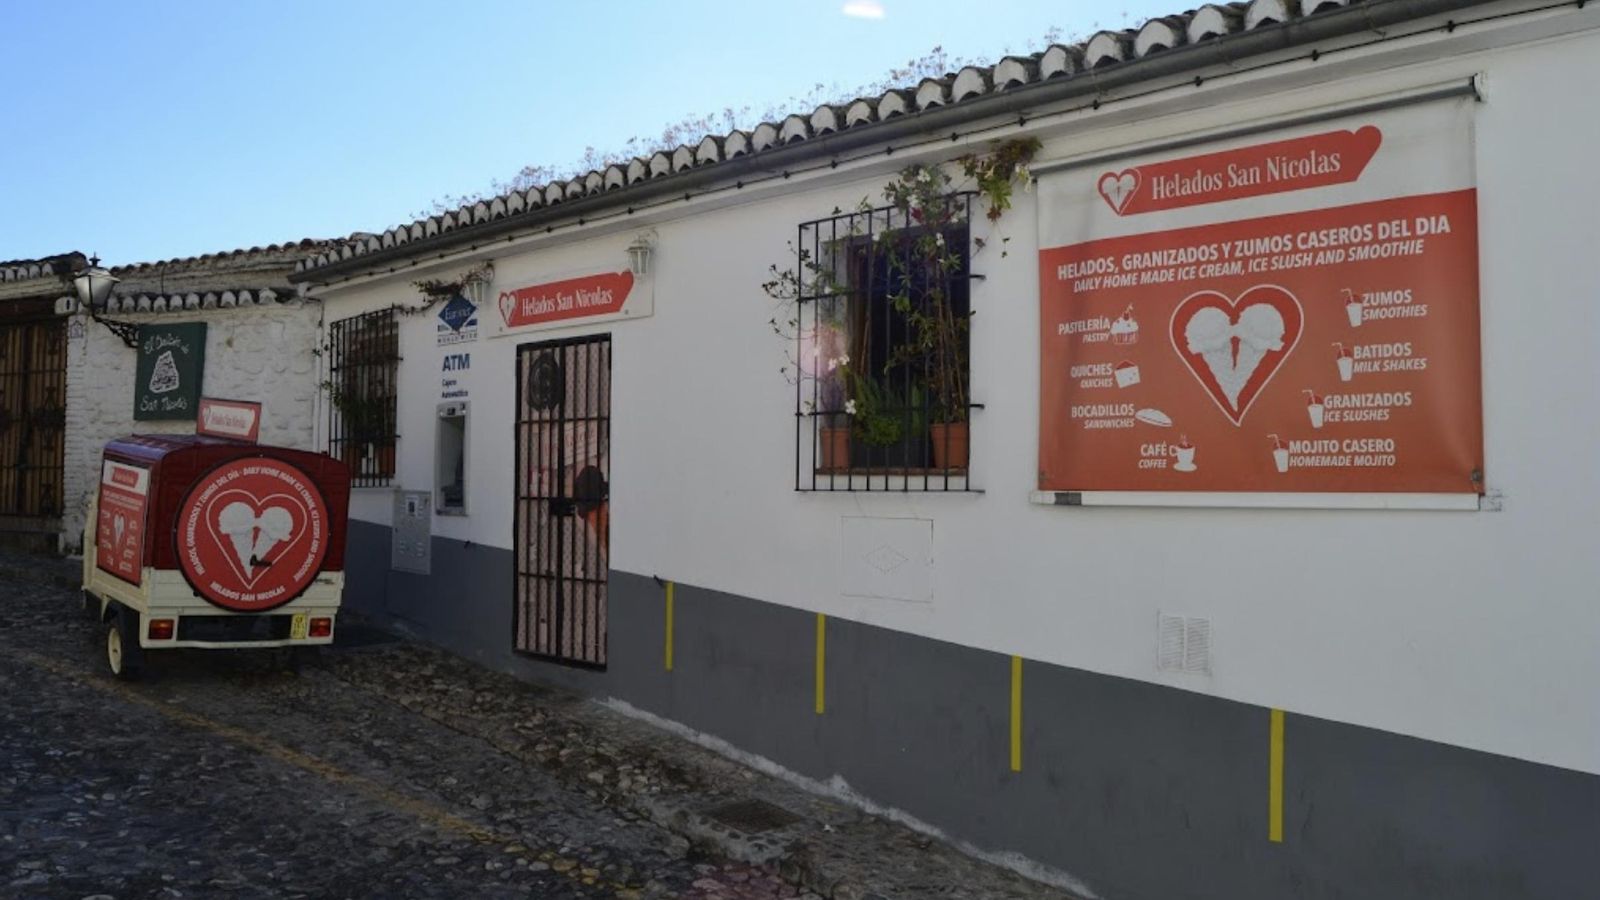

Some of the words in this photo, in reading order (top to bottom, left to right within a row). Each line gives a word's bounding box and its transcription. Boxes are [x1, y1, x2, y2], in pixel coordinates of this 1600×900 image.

[1152, 169, 1223, 200] Helados
[1227, 163, 1261, 188] San
[1267, 150, 1342, 182] Nicolas
[1057, 257, 1120, 280] HELADOS,
[1122, 243, 1218, 271] GRANIZADOS
[1222, 242, 1232, 258] Y
[1234, 233, 1293, 257] ZUMOS
[1296, 224, 1374, 250] CASEROS
[1378, 218, 1412, 240] DEL
[1415, 215, 1452, 236] DIA
[1074, 276, 1102, 293] DAILY
[1103, 273, 1138, 288] HOME
[1140, 269, 1175, 284] MADE
[1177, 266, 1200, 281] ICE
[1200, 262, 1245, 279] CREAM,
[1248, 257, 1268, 273] ICE
[1270, 252, 1313, 271] SLUSH
[1315, 250, 1345, 266] AND
[1348, 239, 1425, 262] SMOOTHIE
[522, 296, 556, 316] Helados
[556, 291, 574, 310] San
[575, 286, 613, 309] Nicolas
[1362, 289, 1413, 306] ZUMOS
[1361, 305, 1428, 321] SMOOTHIES
[1058, 317, 1111, 335] PASTELERÍA
[1082, 333, 1110, 344] PASTRY
[1353, 342, 1412, 359] BATIDOS
[442, 353, 470, 371] ATM
[1353, 360, 1380, 373] MILK
[1381, 358, 1428, 371] SHAKES
[1070, 363, 1113, 378] QUICHES
[1323, 392, 1412, 409] GRANIZADOS
[1071, 403, 1135, 417] BOCADILLOS
[1323, 411, 1341, 422] ICE
[1342, 409, 1390, 421] SLUSHES
[1084, 418, 1135, 429] SANDWICHES
[1140, 441, 1168, 457] CAFÉ
[1288, 438, 1339, 454] MOJITO
[1342, 438, 1395, 452] CASERO
[1138, 458, 1168, 469] COFFEE
[1288, 455, 1352, 467] HOMEMADE
[1353, 455, 1396, 467] MOJITO
